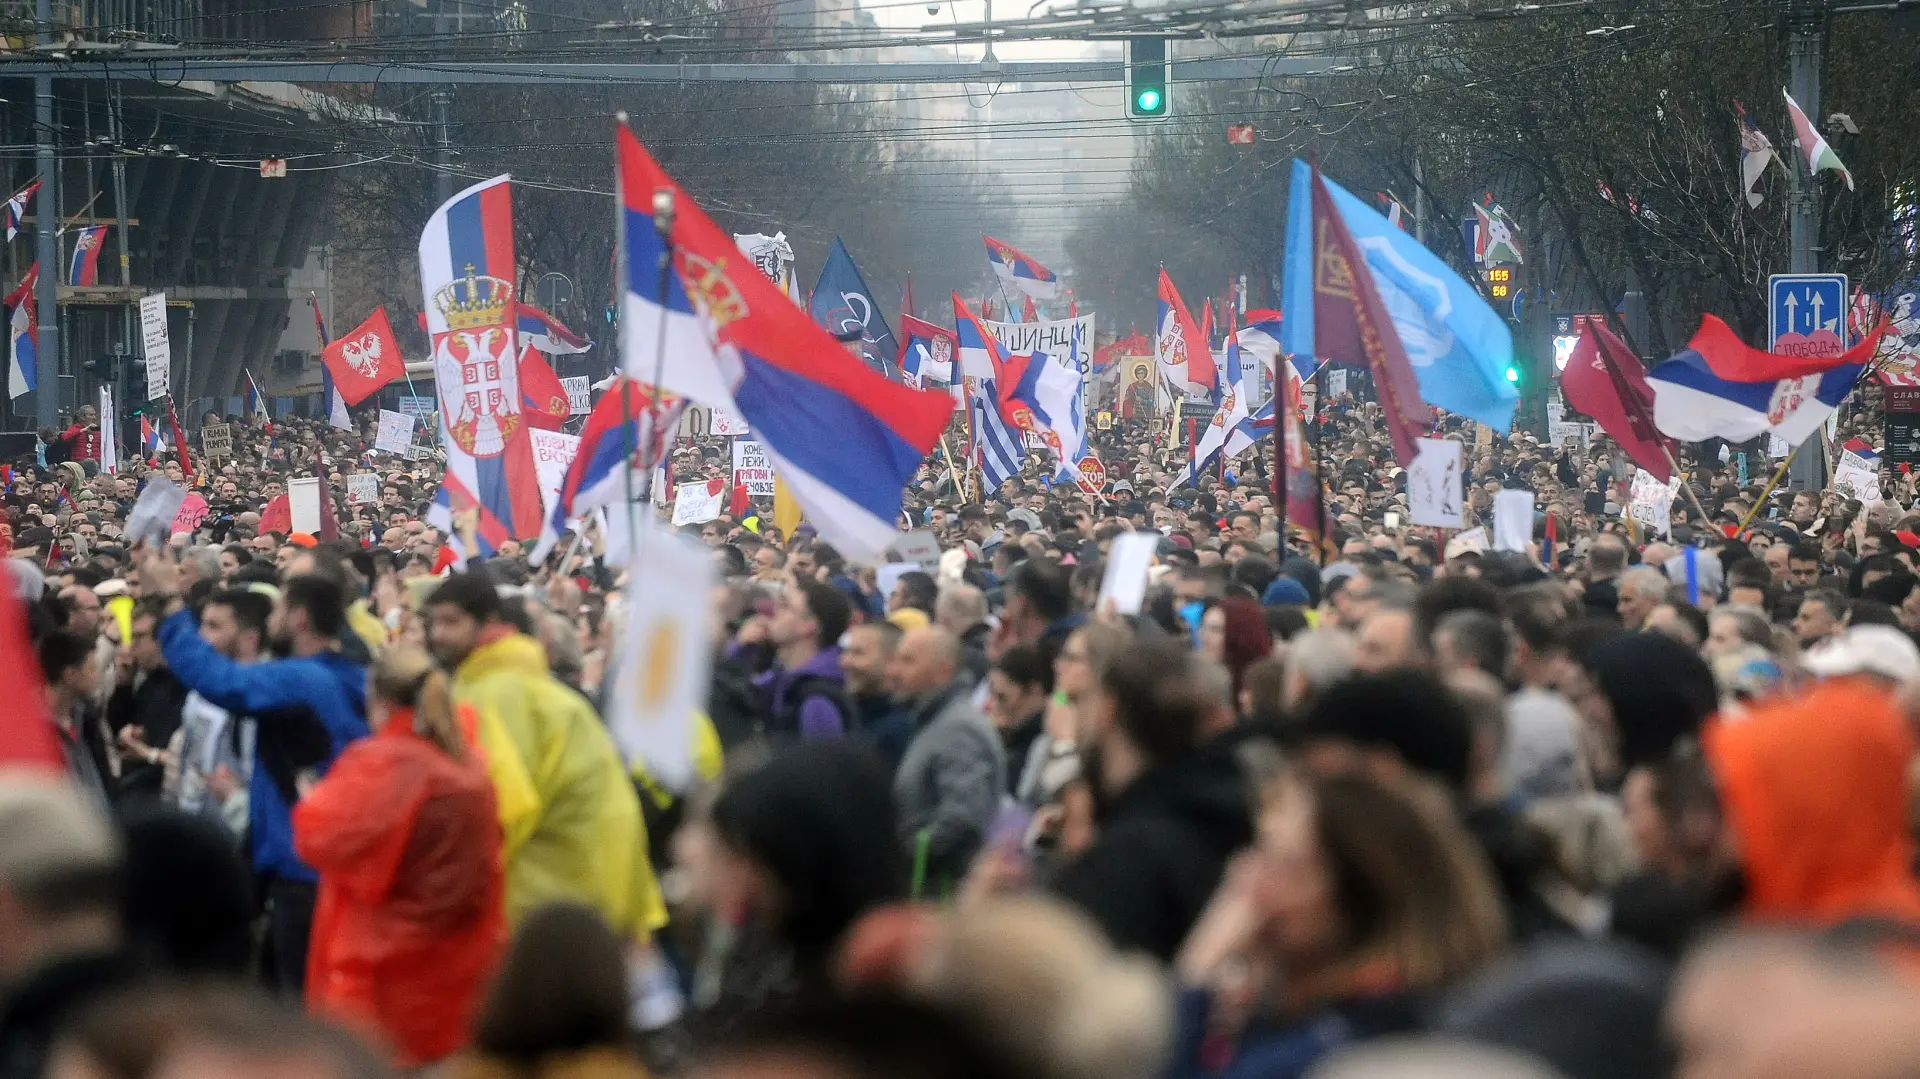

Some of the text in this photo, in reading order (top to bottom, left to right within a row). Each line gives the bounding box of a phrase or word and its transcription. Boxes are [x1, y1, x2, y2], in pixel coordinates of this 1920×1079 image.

[1489, 270, 1509, 281] 155
[740, 456, 765, 468] ЛЕЖИ
[742, 481, 774, 493] ЕЧОВЈЕ
